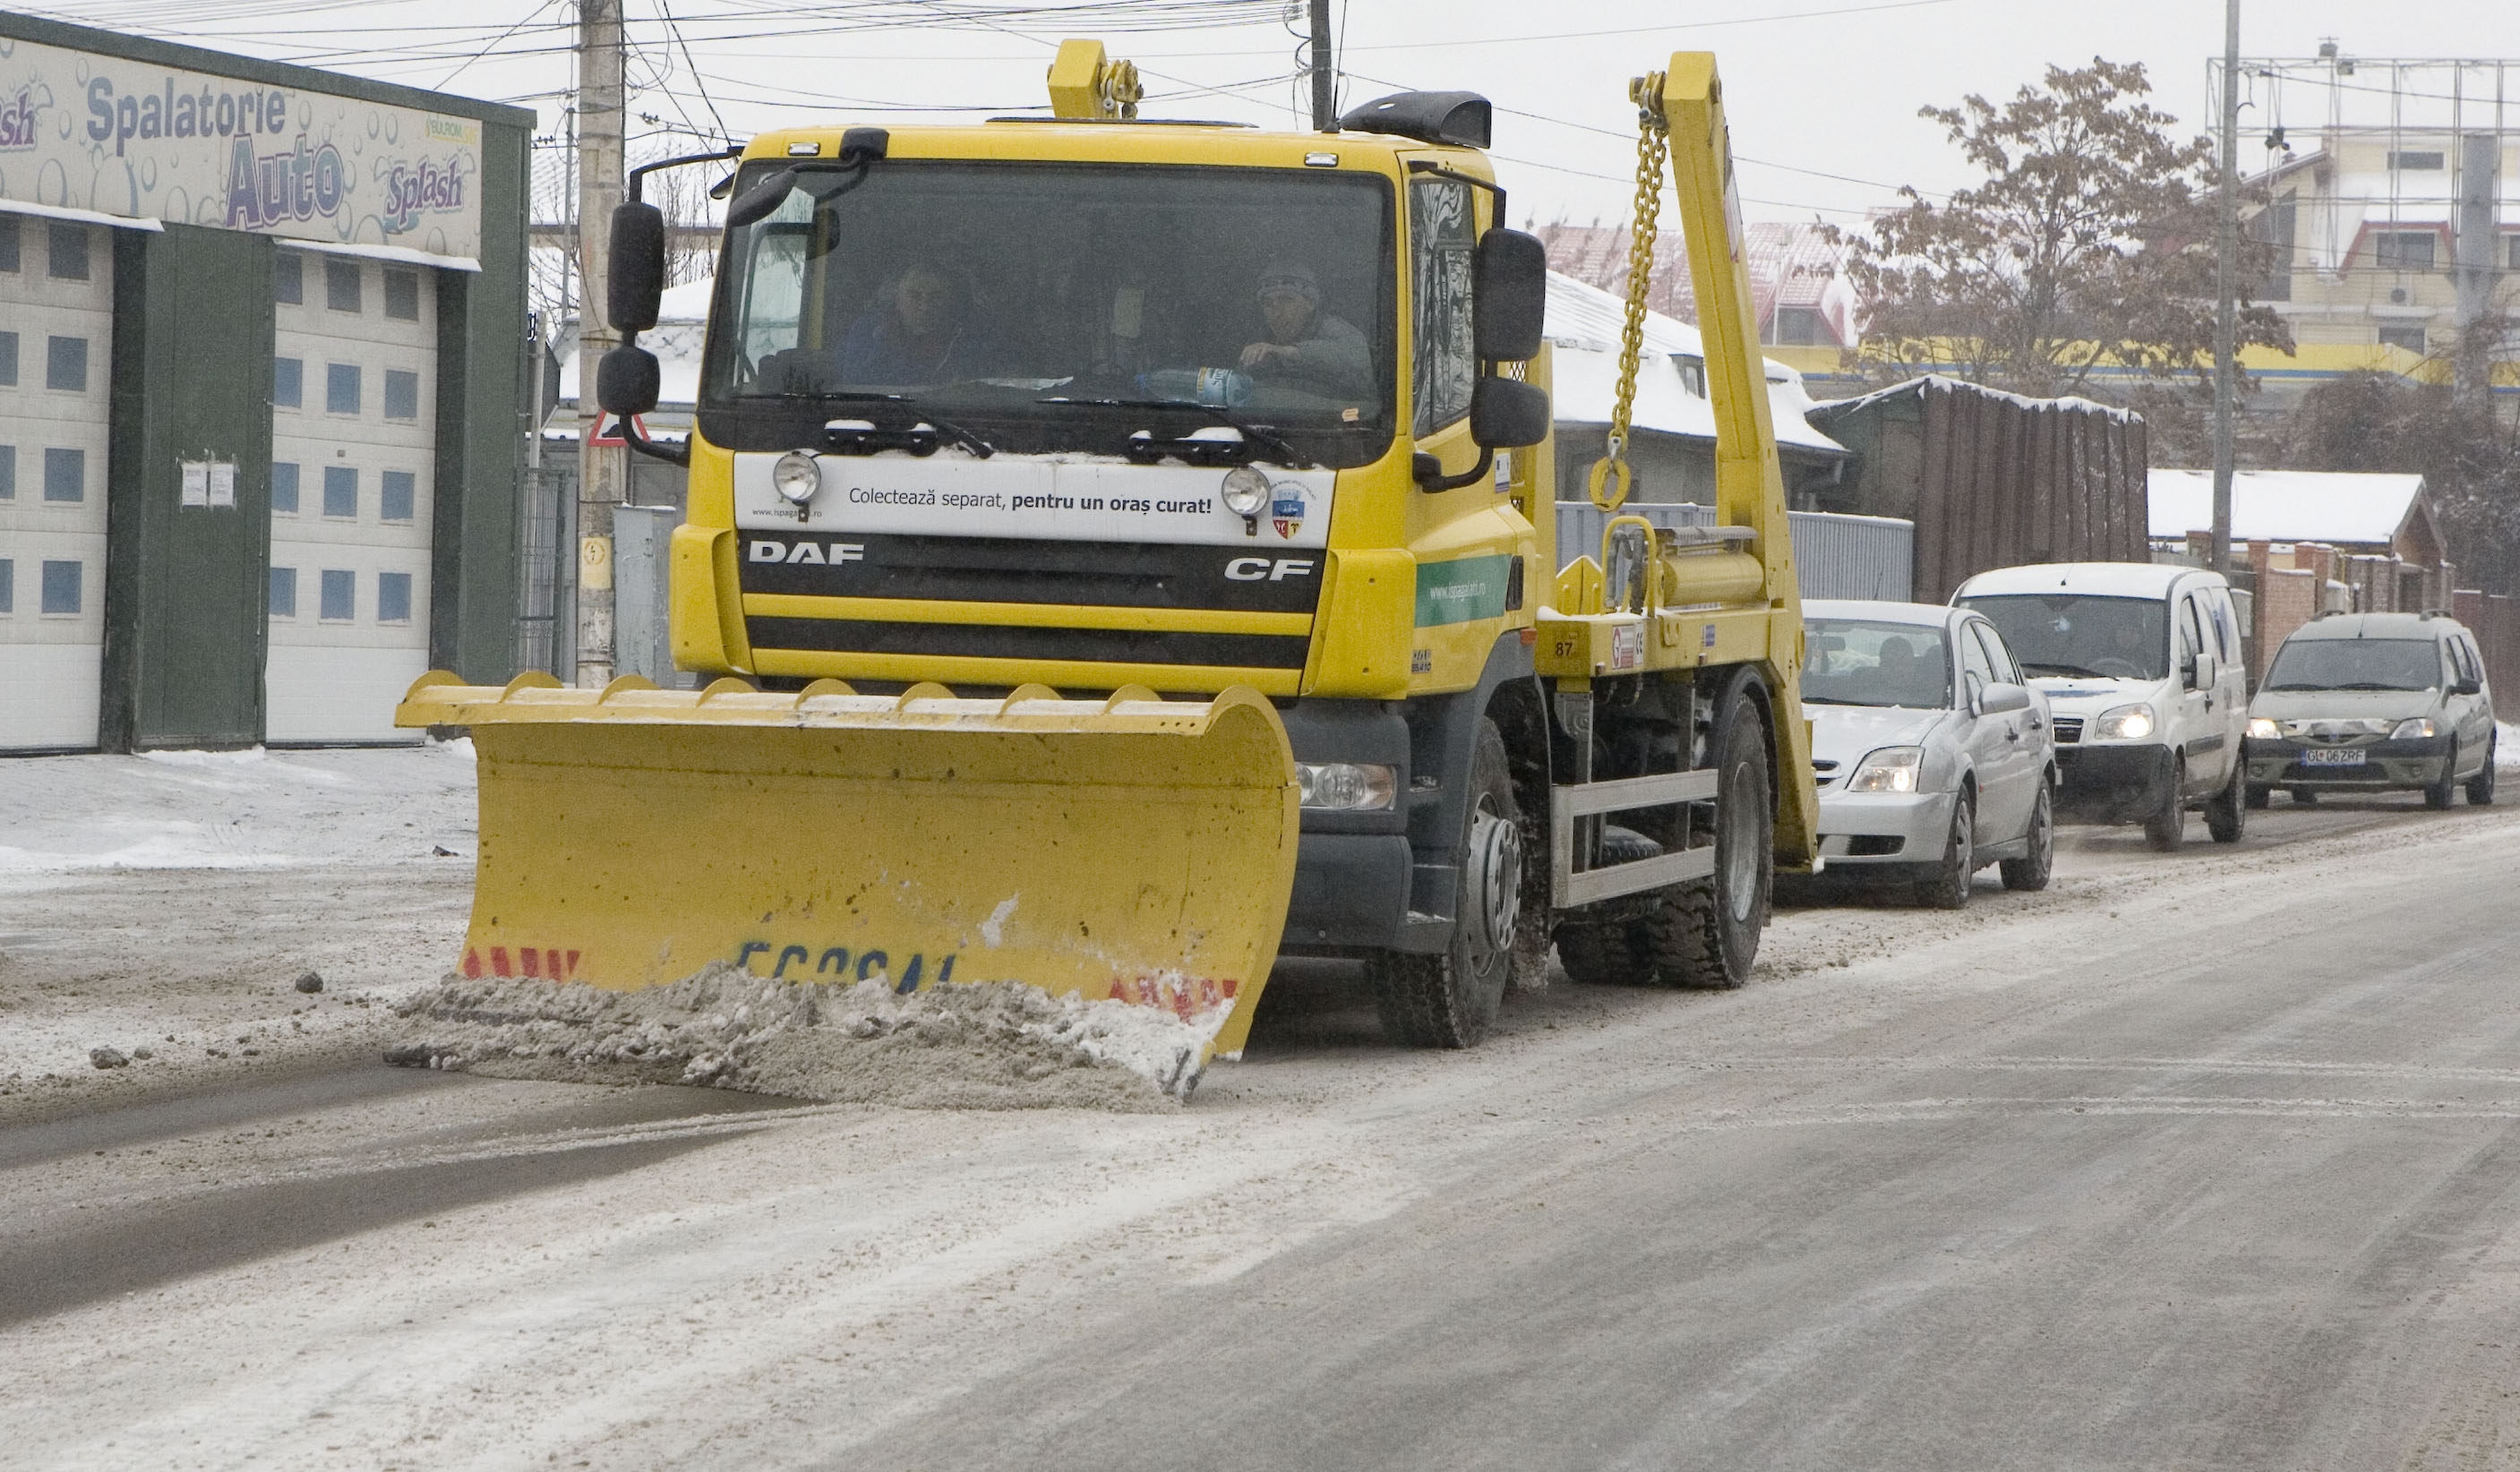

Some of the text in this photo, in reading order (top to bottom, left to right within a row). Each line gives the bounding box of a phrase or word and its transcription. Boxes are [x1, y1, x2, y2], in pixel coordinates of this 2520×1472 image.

[87, 76, 286, 157] Spalatorie
[226, 133, 344, 230] Auto
[386, 160, 463, 226] Splash
[752, 508, 822, 518] www.ispaga.ro
[849, 488, 1213, 516] Colectează separat, pentru un oraș curat!
[749, 541, 865, 565] DAF
[1224, 557, 1315, 581] CF
[1556, 642, 1573, 656] 87
[2308, 750, 2322, 762] GL
